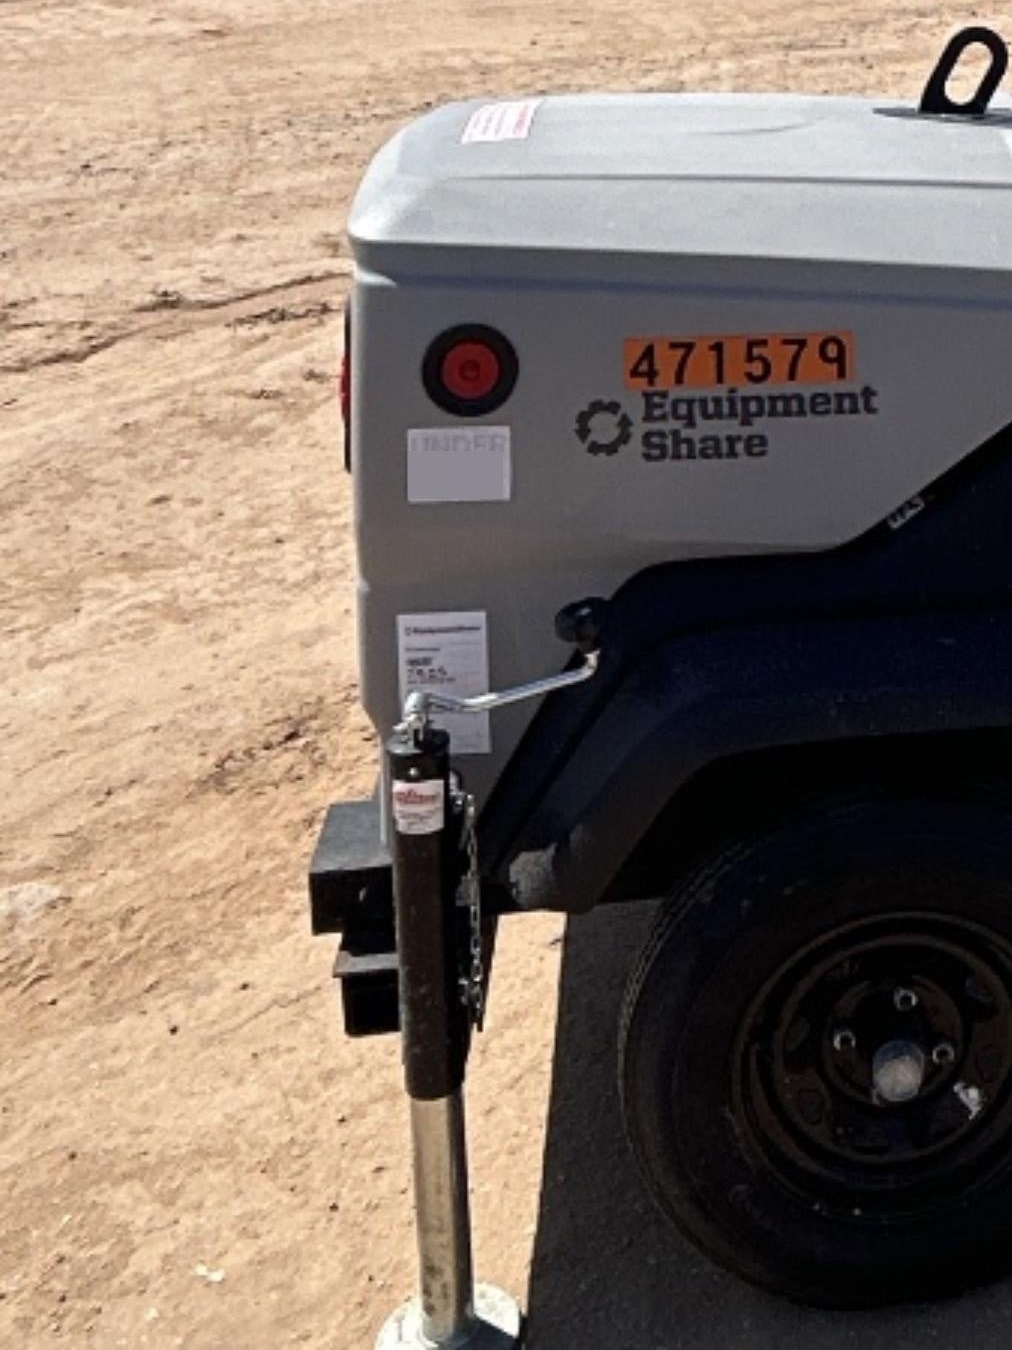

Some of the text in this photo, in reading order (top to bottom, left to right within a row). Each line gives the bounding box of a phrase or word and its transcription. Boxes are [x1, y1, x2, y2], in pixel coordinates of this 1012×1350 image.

[628, 335, 849, 387] 471579
[641, 386, 879, 428] Equipment
[641, 427, 770, 462] Share
